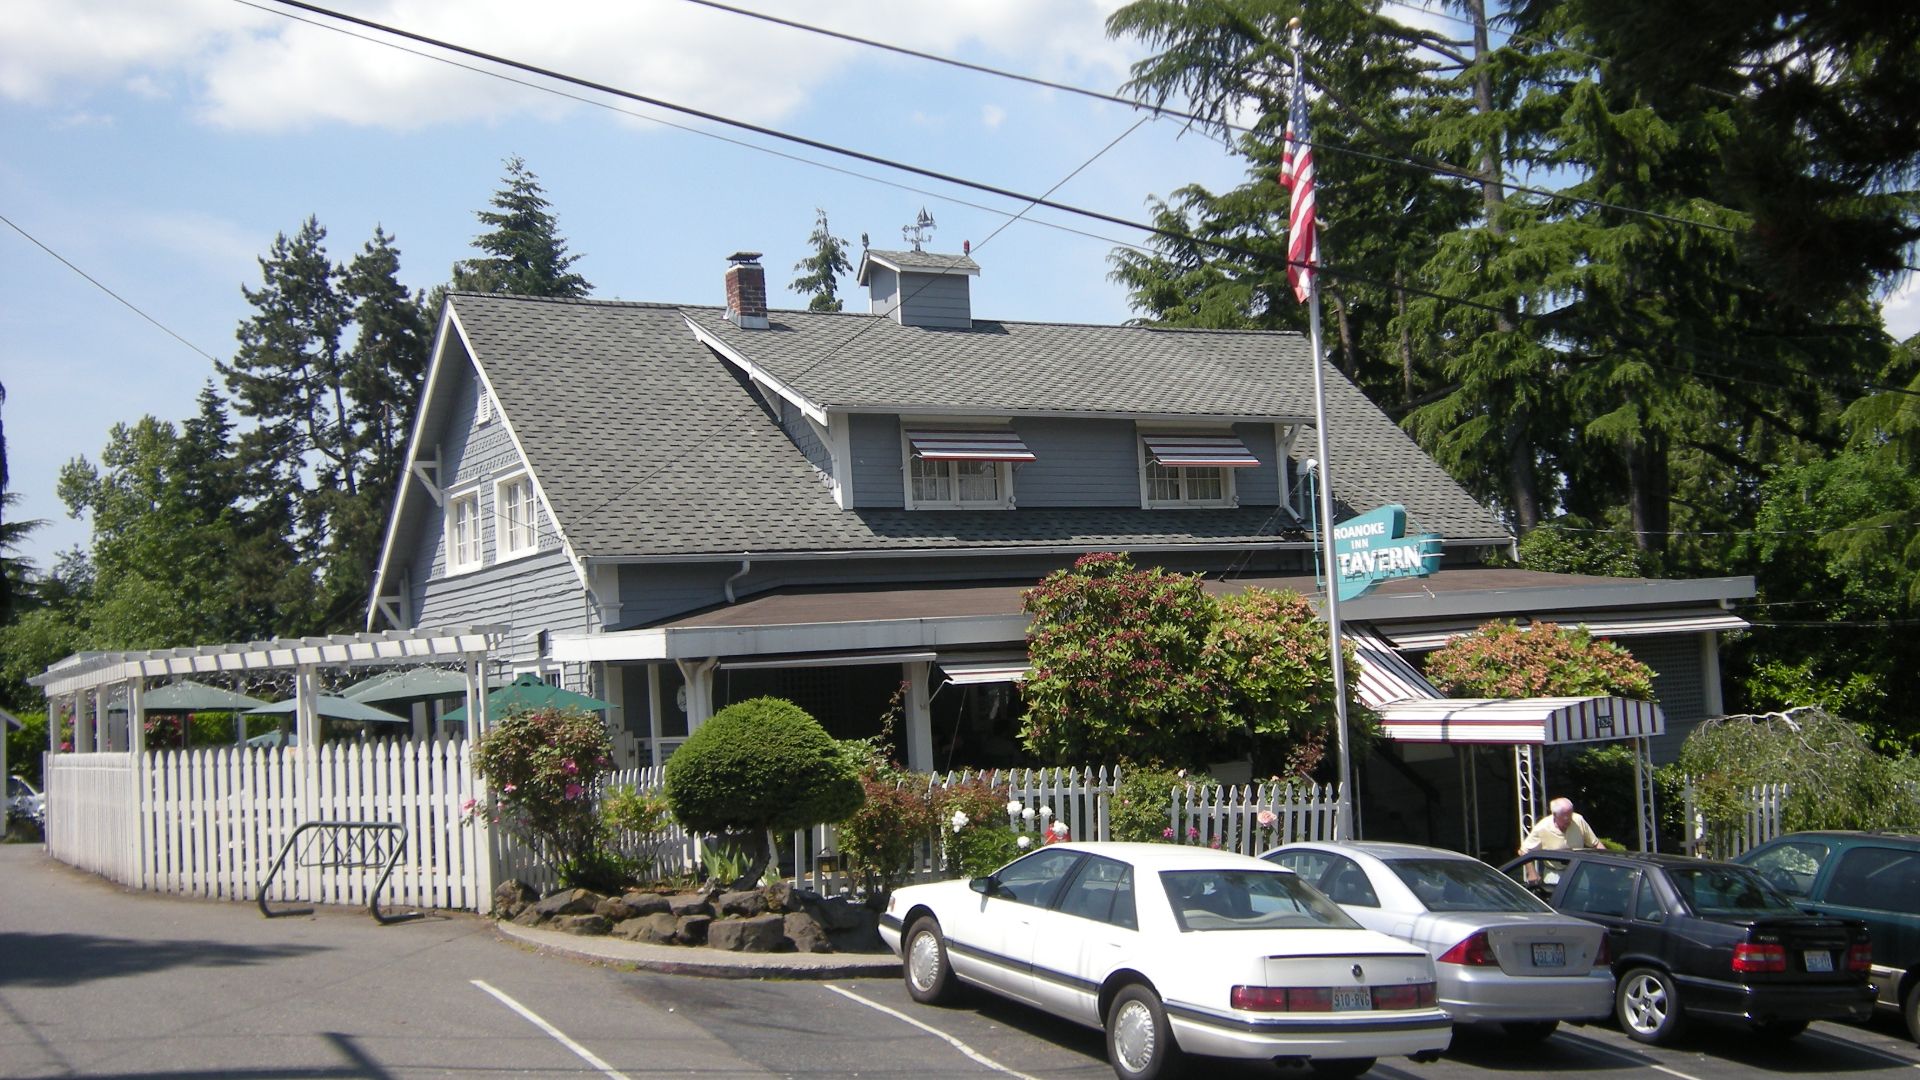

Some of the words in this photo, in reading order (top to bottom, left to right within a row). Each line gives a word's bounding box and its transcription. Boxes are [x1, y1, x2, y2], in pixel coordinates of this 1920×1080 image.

[1333, 522, 1385, 540] ROANOKE
[1351, 538, 1369, 550] INN
[1336, 545, 1422, 576] TAVERN
